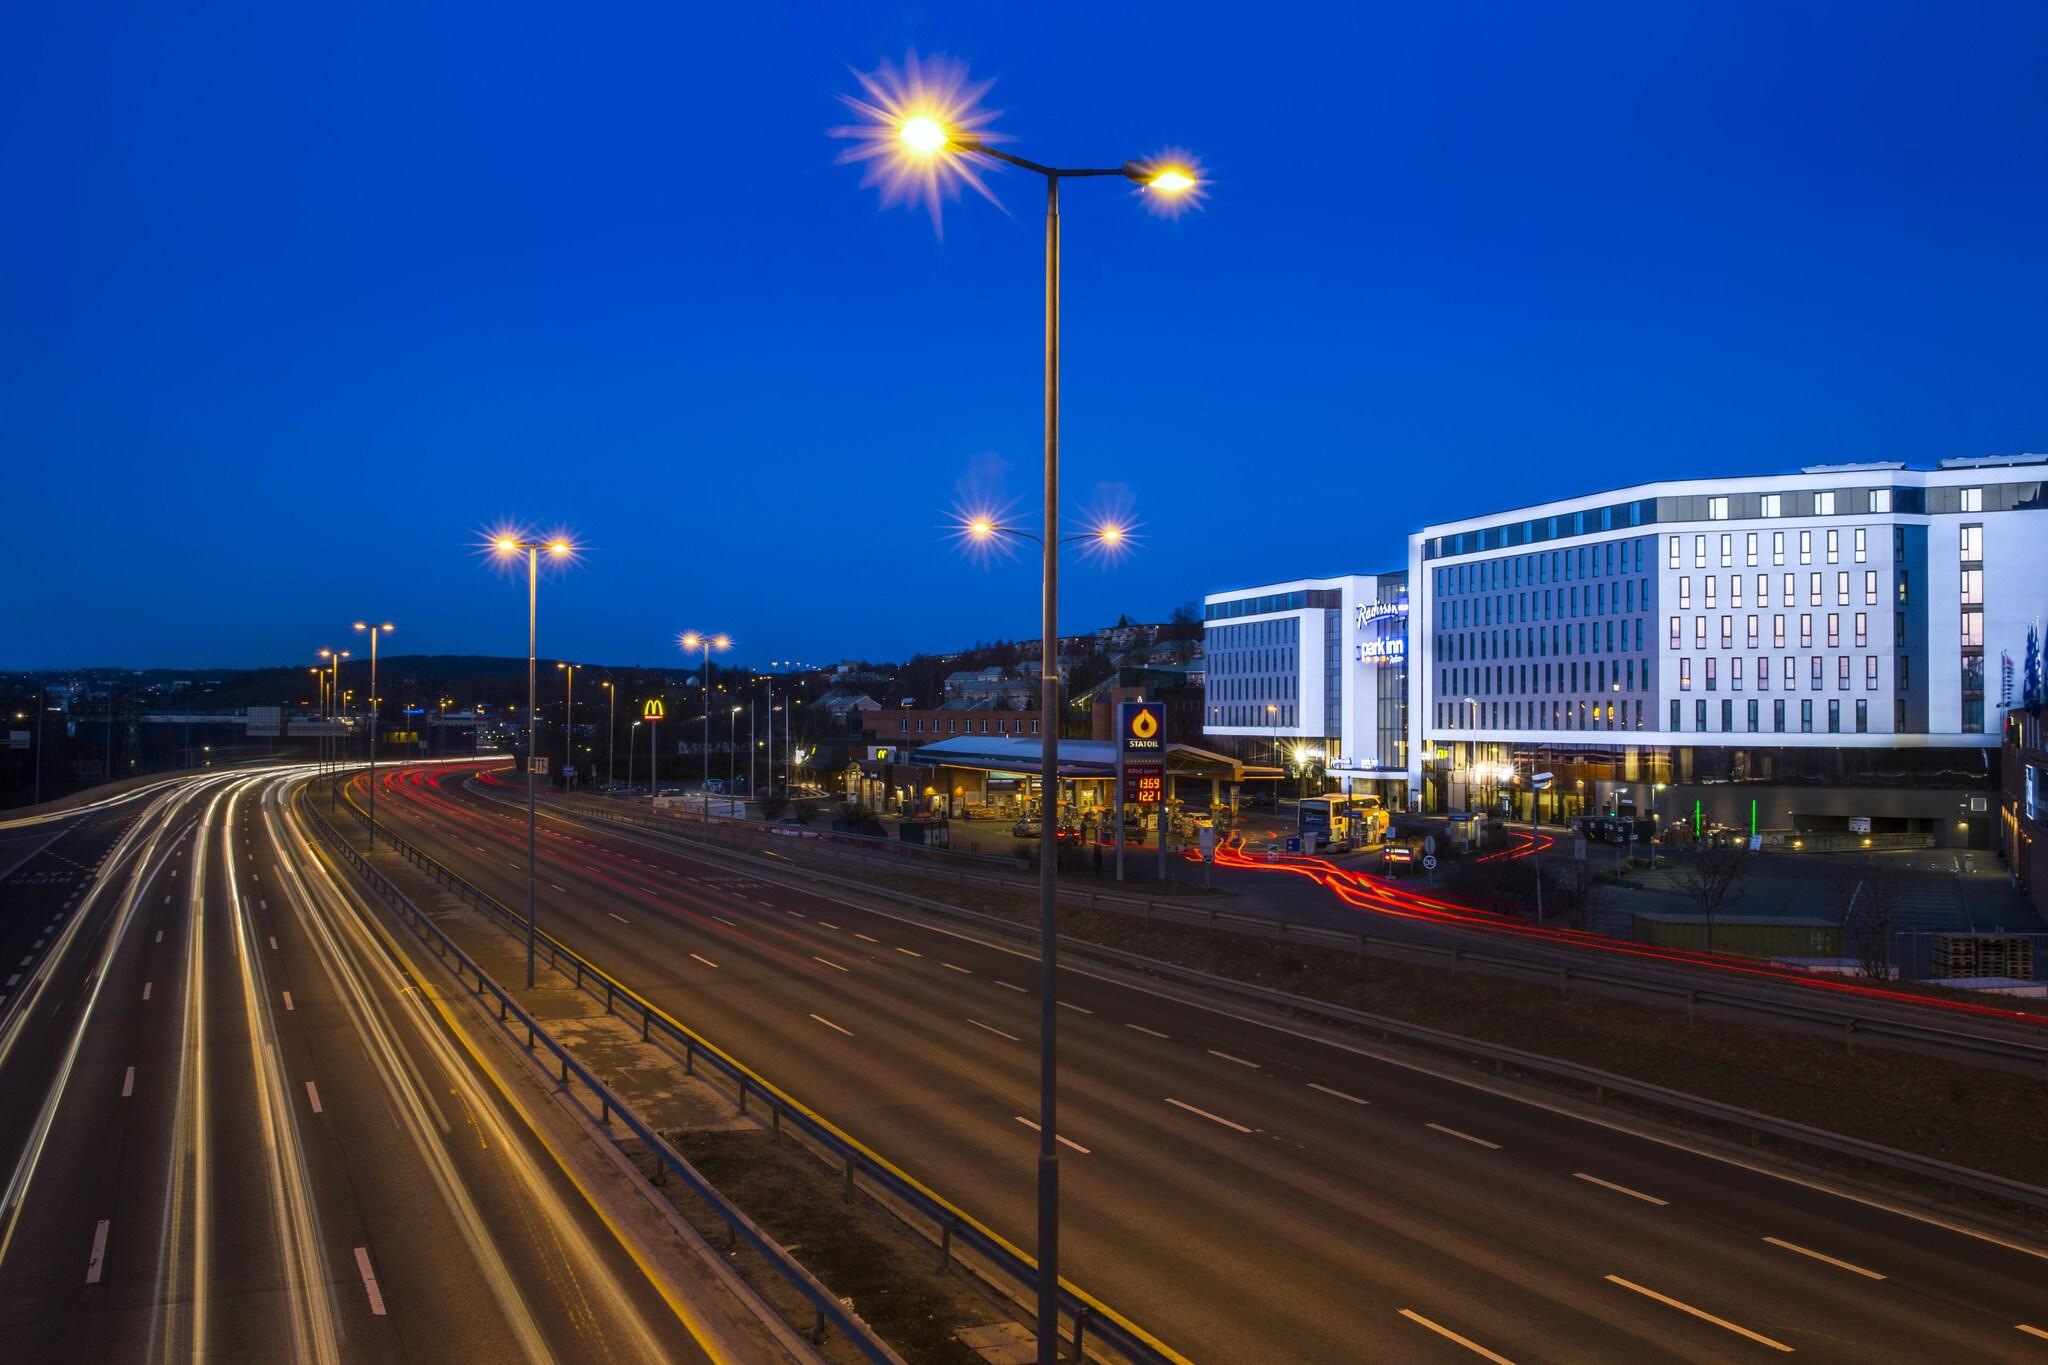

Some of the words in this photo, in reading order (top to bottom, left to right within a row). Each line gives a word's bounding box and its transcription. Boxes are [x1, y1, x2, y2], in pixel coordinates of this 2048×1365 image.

[1357, 599, 1398, 629] Radisson
[1361, 636, 1385, 662] park
[1386, 636, 1402, 654] inn
[1129, 740, 1159, 748] STATOIL
